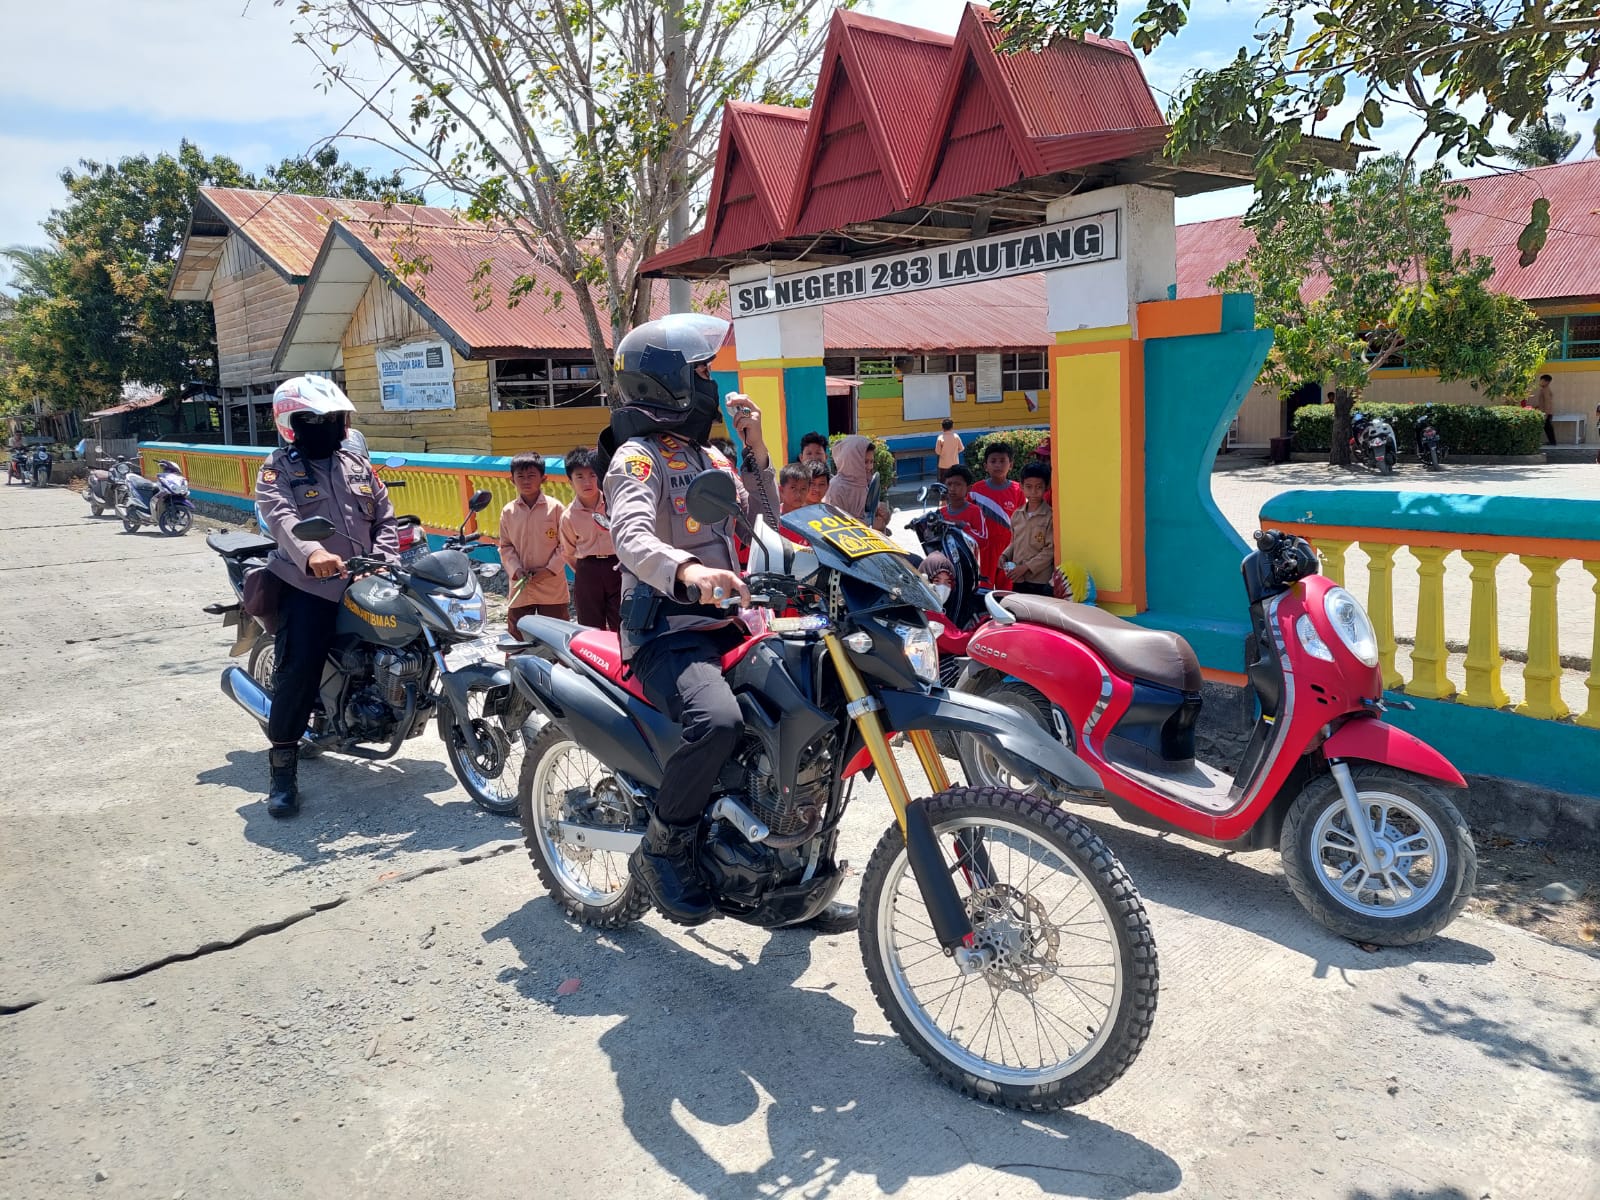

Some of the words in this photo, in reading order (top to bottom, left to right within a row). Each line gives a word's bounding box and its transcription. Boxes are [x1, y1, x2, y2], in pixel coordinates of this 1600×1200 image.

[739, 286, 770, 312] SD
[775, 267, 865, 305] NEGERI
[871, 256, 931, 290] 283
[938, 223, 1103, 280] LAUTANG
[579, 647, 610, 671] HONDA
